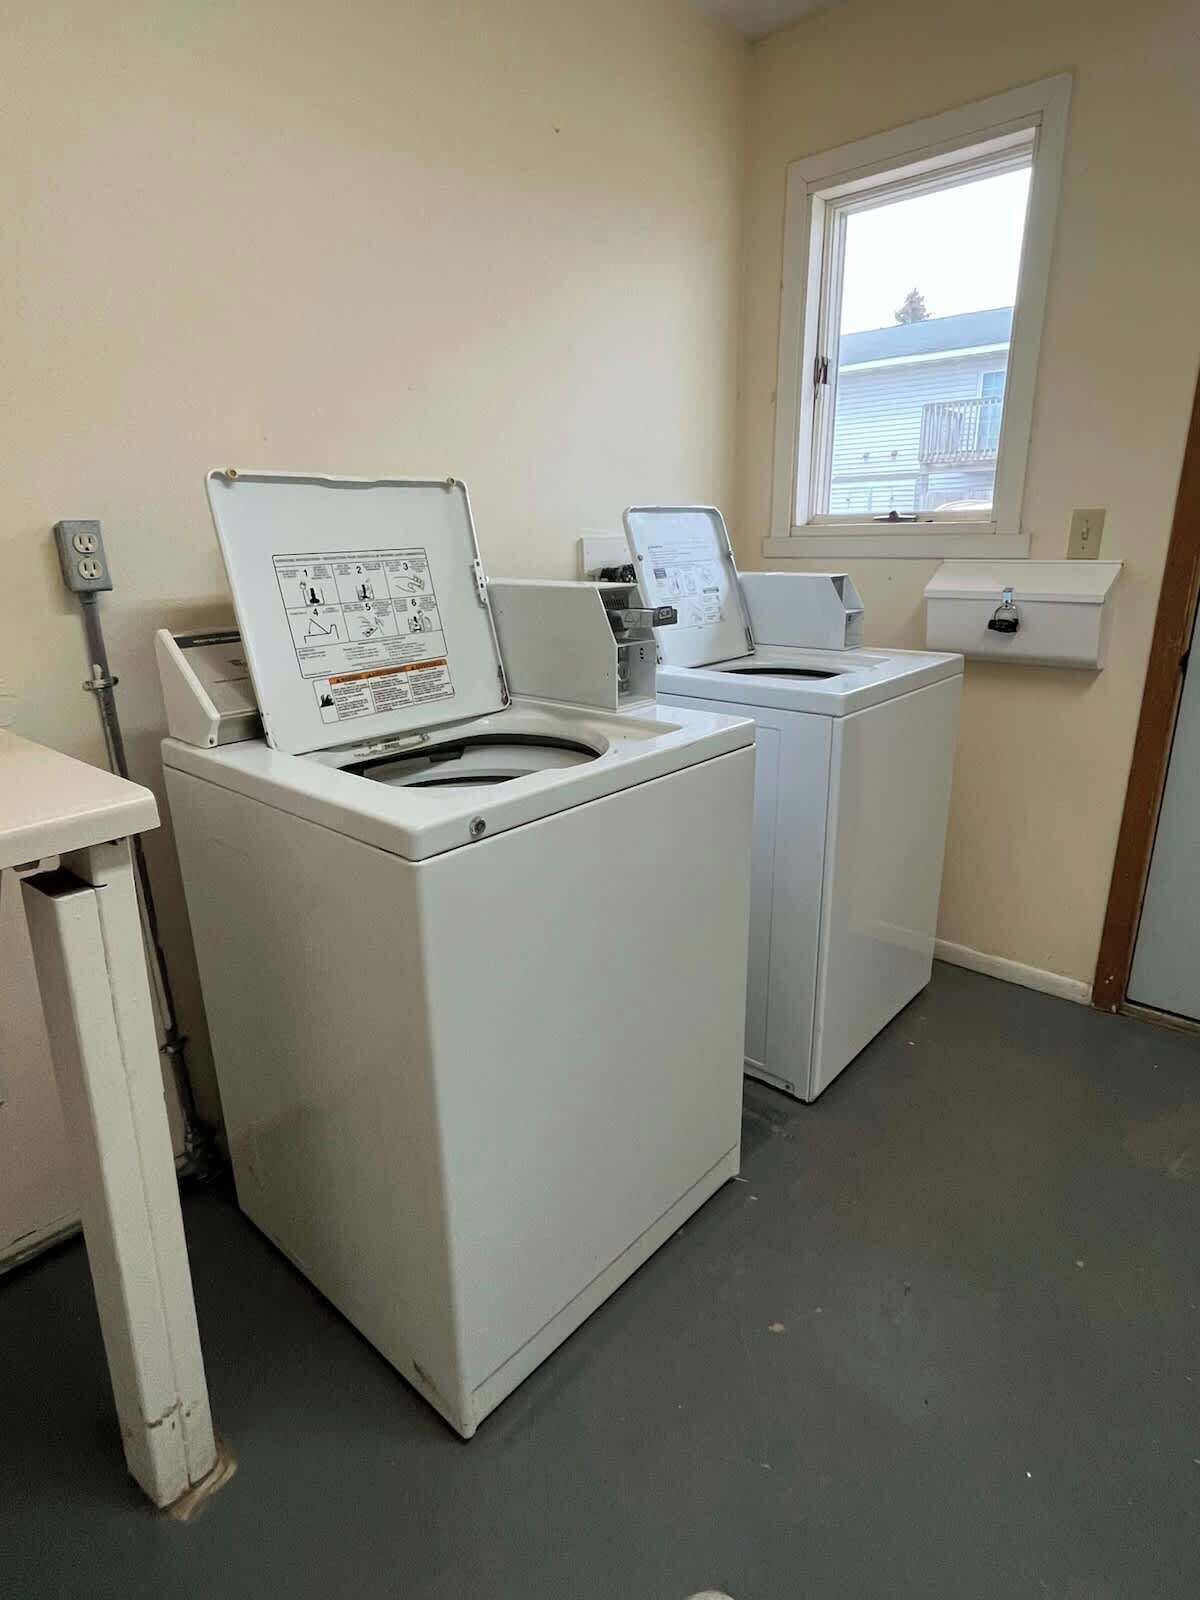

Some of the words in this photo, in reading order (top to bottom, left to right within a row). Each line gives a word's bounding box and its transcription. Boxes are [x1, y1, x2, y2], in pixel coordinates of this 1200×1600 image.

[356, 566, 362, 574] 2
[402, 562, 408, 571] 3
[303, 569, 308, 577] 1
[411, 598, 418, 606] 6
[365, 603, 371, 611] 5
[312, 608, 319, 616] 4
